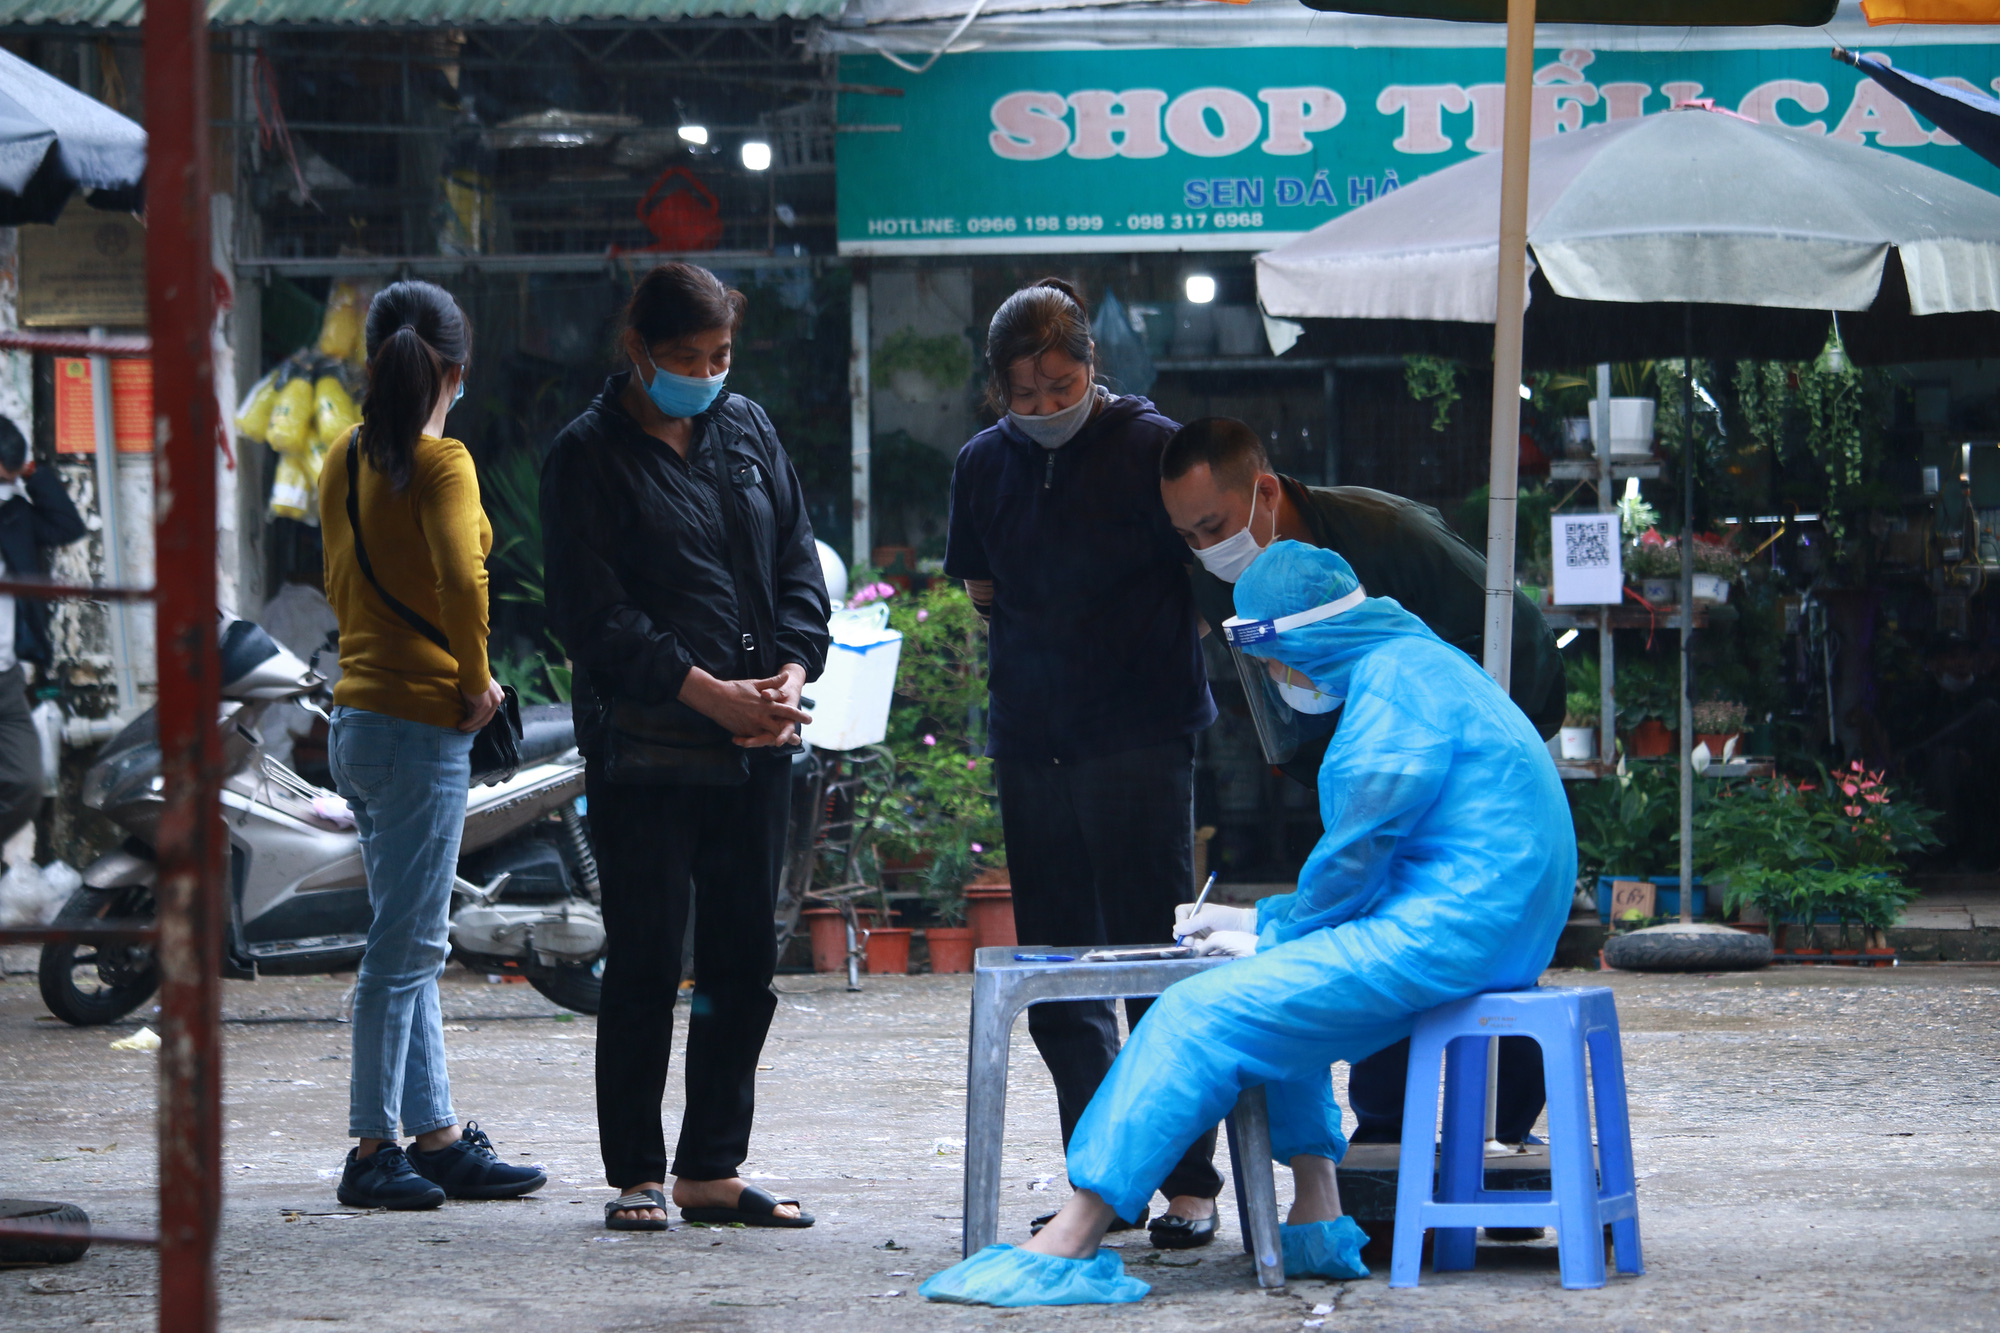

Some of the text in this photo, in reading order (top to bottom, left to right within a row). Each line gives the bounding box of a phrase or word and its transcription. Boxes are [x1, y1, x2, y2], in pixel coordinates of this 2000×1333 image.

[989, 86, 1346, 160] SHOP
[1184, 177, 1264, 209] SEN
[1274, 169, 1338, 206] ĐÁ
[868, 217, 961, 235] HOTLINE:
[967, 216, 1017, 233] 0966
[1025, 215, 1060, 231] 198
[1066, 214, 1103, 231] 999
[1127, 212, 1165, 230] 098
[1170, 212, 1208, 230] 317
[1213, 211, 1263, 228] 6968
